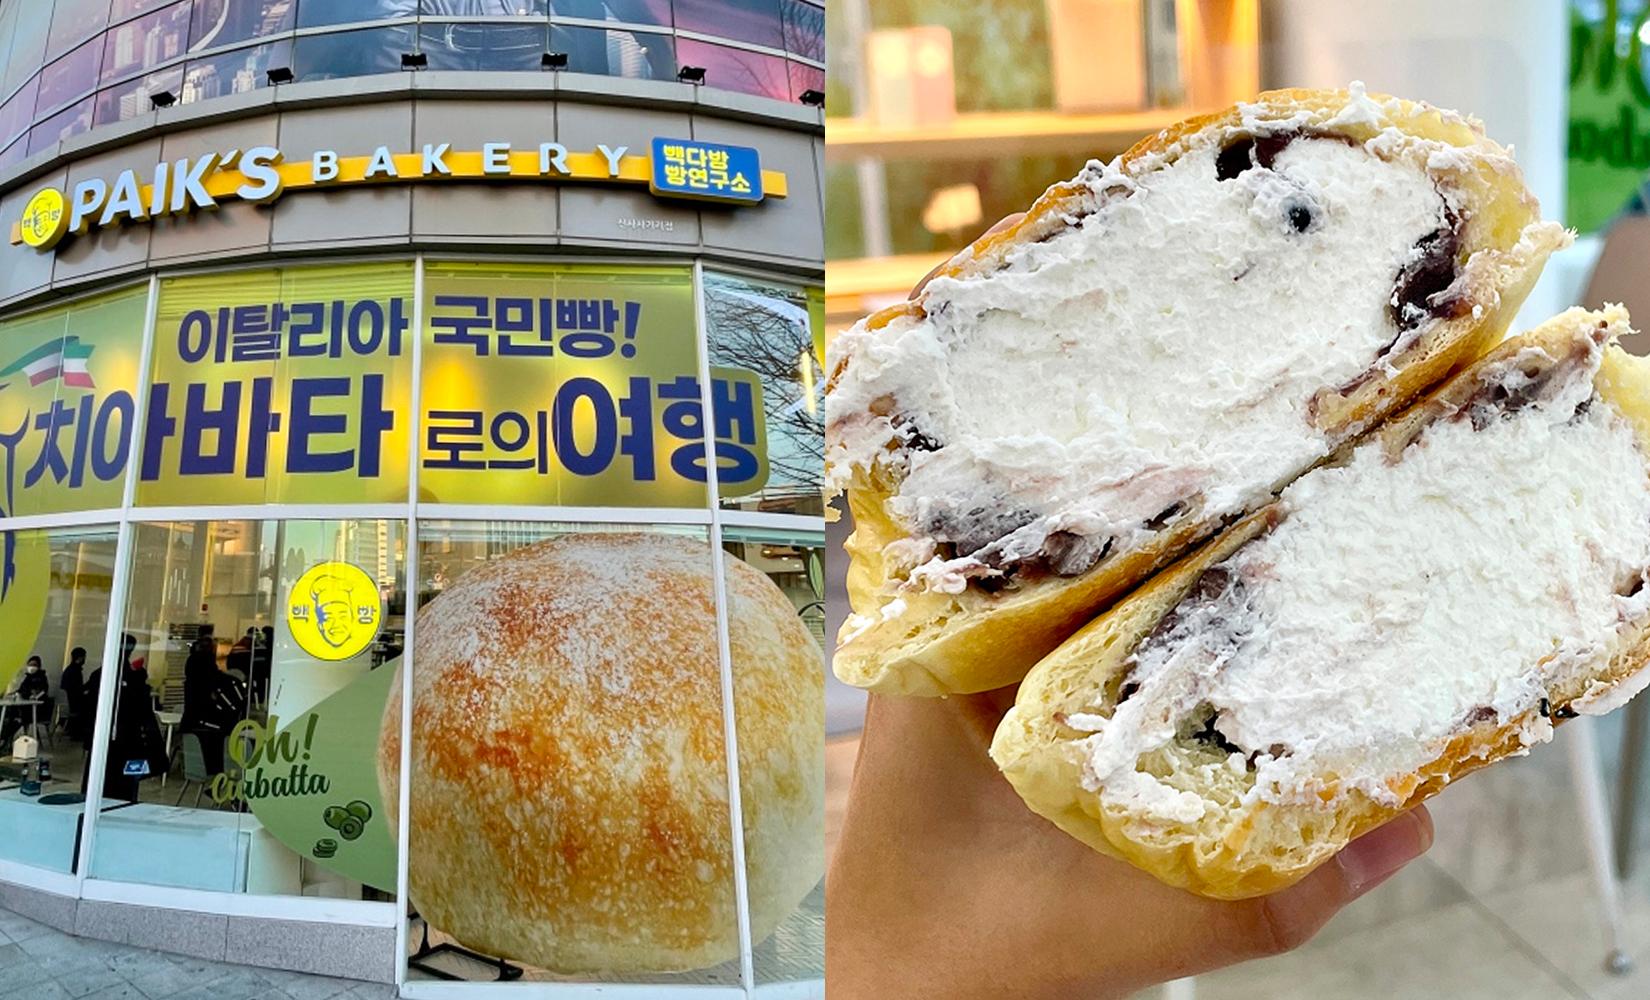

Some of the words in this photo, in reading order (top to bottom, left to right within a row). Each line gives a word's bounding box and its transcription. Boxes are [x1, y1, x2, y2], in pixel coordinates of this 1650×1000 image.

[69, 146, 282, 233] PAIK'S
[312, 142, 628, 182] BAKERY
[178, 297, 409, 364] 이탈리아
[430, 295, 642, 359] 국민빵!
[552, 376, 760, 484] 여행
[228, 712, 319, 770] Oh!
